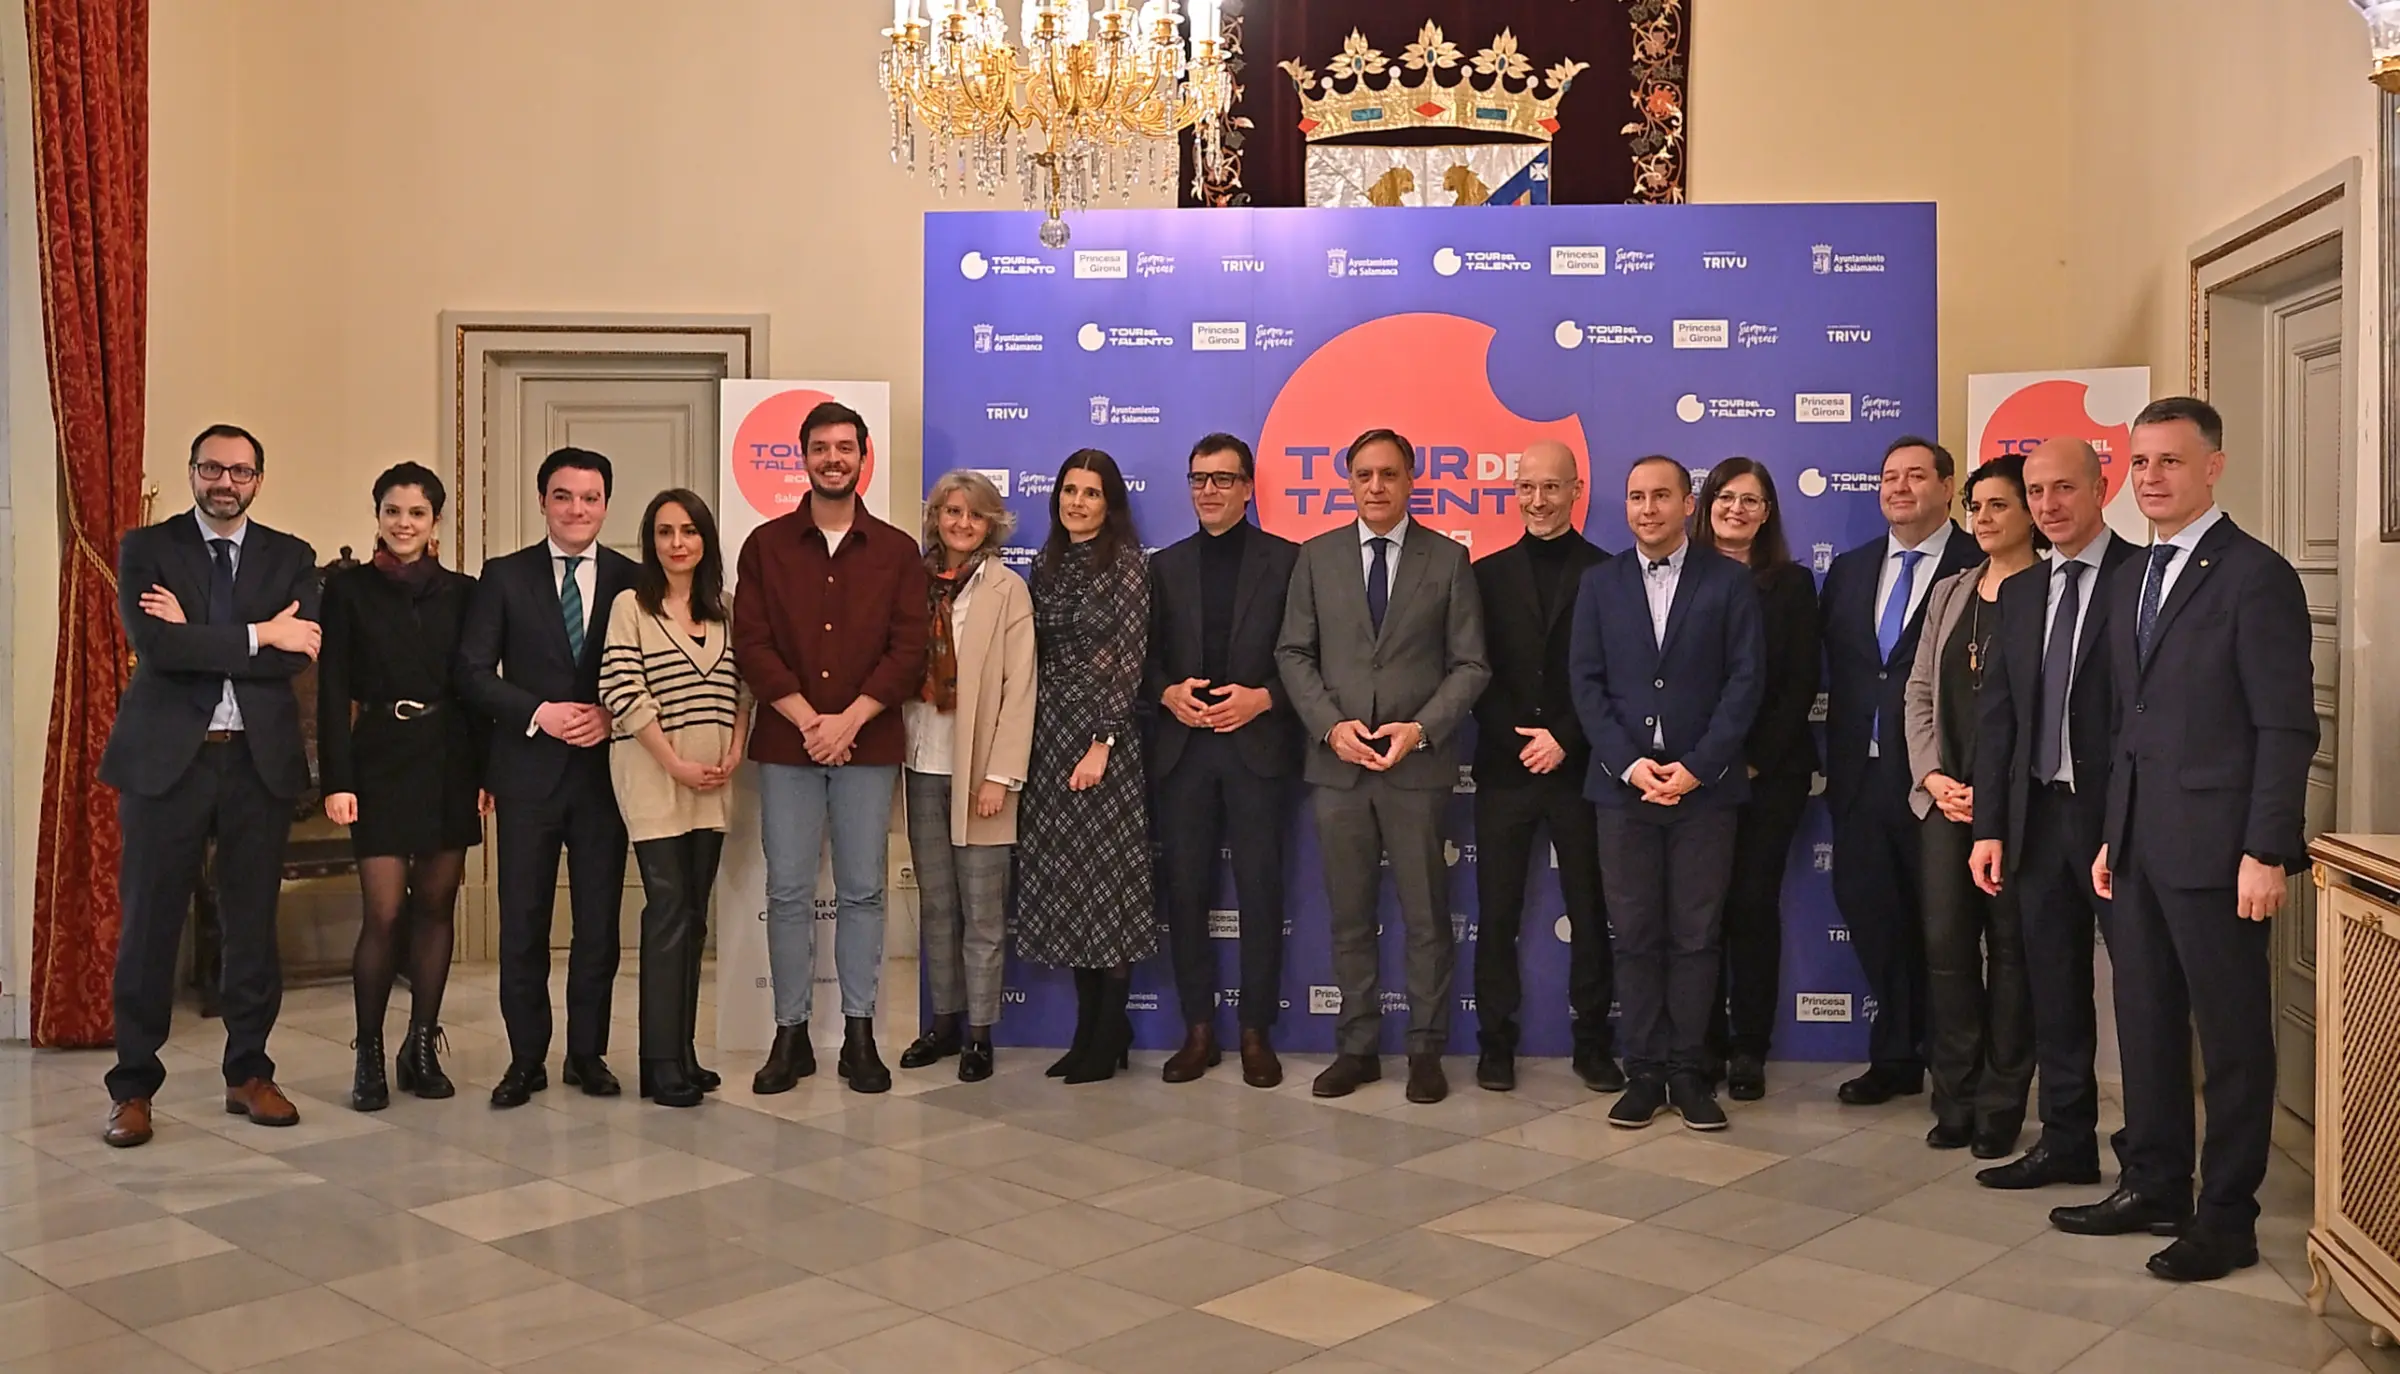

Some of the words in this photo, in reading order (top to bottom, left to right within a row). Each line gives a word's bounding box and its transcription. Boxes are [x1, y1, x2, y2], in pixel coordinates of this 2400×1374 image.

[1079, 254, 1121, 262] Princesa
[1465, 252, 1501, 261] TOUR
[1556, 250, 1599, 259] Princesa
[1834, 254, 1885, 264] Ayuntamiento
[992, 255, 1026, 265] TOUR
[1349, 258, 1399, 267] Ayuntamiento
[1567, 260, 1599, 269] Girona
[1703, 257, 1748, 269] TRIVU
[992, 265, 1056, 274] TALENTO
[1089, 264, 1121, 272] Girona
[1221, 260, 1265, 272] TRIVU
[1465, 262, 1532, 271] TALENTO
[1834, 263, 1843, 272] de
[1845, 263, 1885, 272] Salamanca
[1349, 266, 1358, 276] de
[1359, 266, 1399, 276] Salamanca
[1109, 327, 1143, 336] TOUR
[1198, 326, 1239, 334] Princesa
[1587, 325, 1623, 334] TOUR
[1678, 323, 1721, 332] Princesa
[994, 333, 1043, 343] Ayuntamiento
[1207, 336, 1240, 344] Girona
[1587, 335, 1653, 344] TALENTO
[1689, 334, 1722, 343] Girona
[1826, 330, 1871, 342] TRIVU
[1109, 337, 1174, 346] TALENTO
[994, 342, 1003, 351] de
[1005, 342, 1043, 351] Salamanca
[1709, 399, 1744, 408] TOUR
[1801, 397, 1844, 406] Princesa
[986, 408, 1029, 420] TRIVU
[1110, 405, 1160, 415] Ayuntamiento
[1709, 408, 1776, 417] TALENTO
[1812, 407, 1845, 417] Girona
[1110, 414, 1120, 424] de
[1121, 414, 1160, 424] Salamanca
[750, 460, 806, 470] TALE
[1477, 453, 1523, 480] DE
[1831, 473, 1867, 482] TOUR
[1831, 483, 1881, 492] TALEN
[1285, 488, 1516, 515] TAENT
[1000, 547, 1024, 555] OUR
[815, 910, 837, 920] Leó
[1828, 930, 1850, 941] TRI
[1002, 992, 1026, 1003] IVU
[1315, 989, 1340, 998] Princ
[1801, 996, 1845, 1005] Princesa
[1812, 1007, 1846, 1016] Girona
